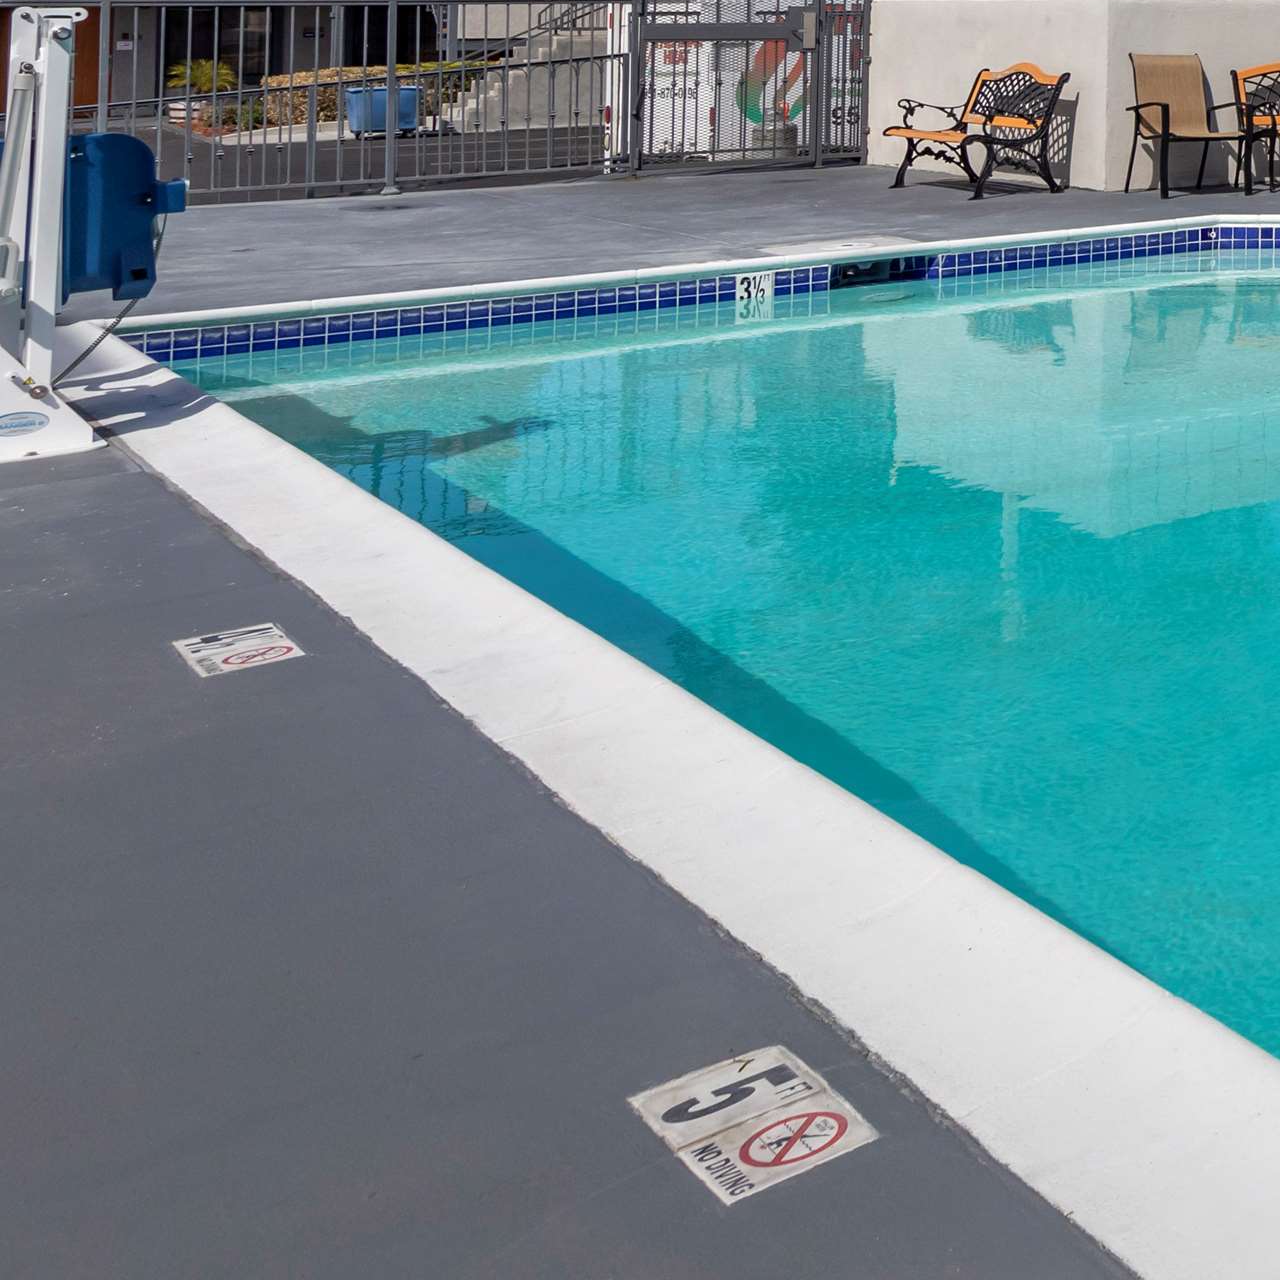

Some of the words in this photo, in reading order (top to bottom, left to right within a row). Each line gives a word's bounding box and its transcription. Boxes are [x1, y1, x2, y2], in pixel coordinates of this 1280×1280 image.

[661, 1063, 799, 1123] 5
[691, 1142, 722, 1162] NO
[705, 1157, 755, 1196] DIVING
